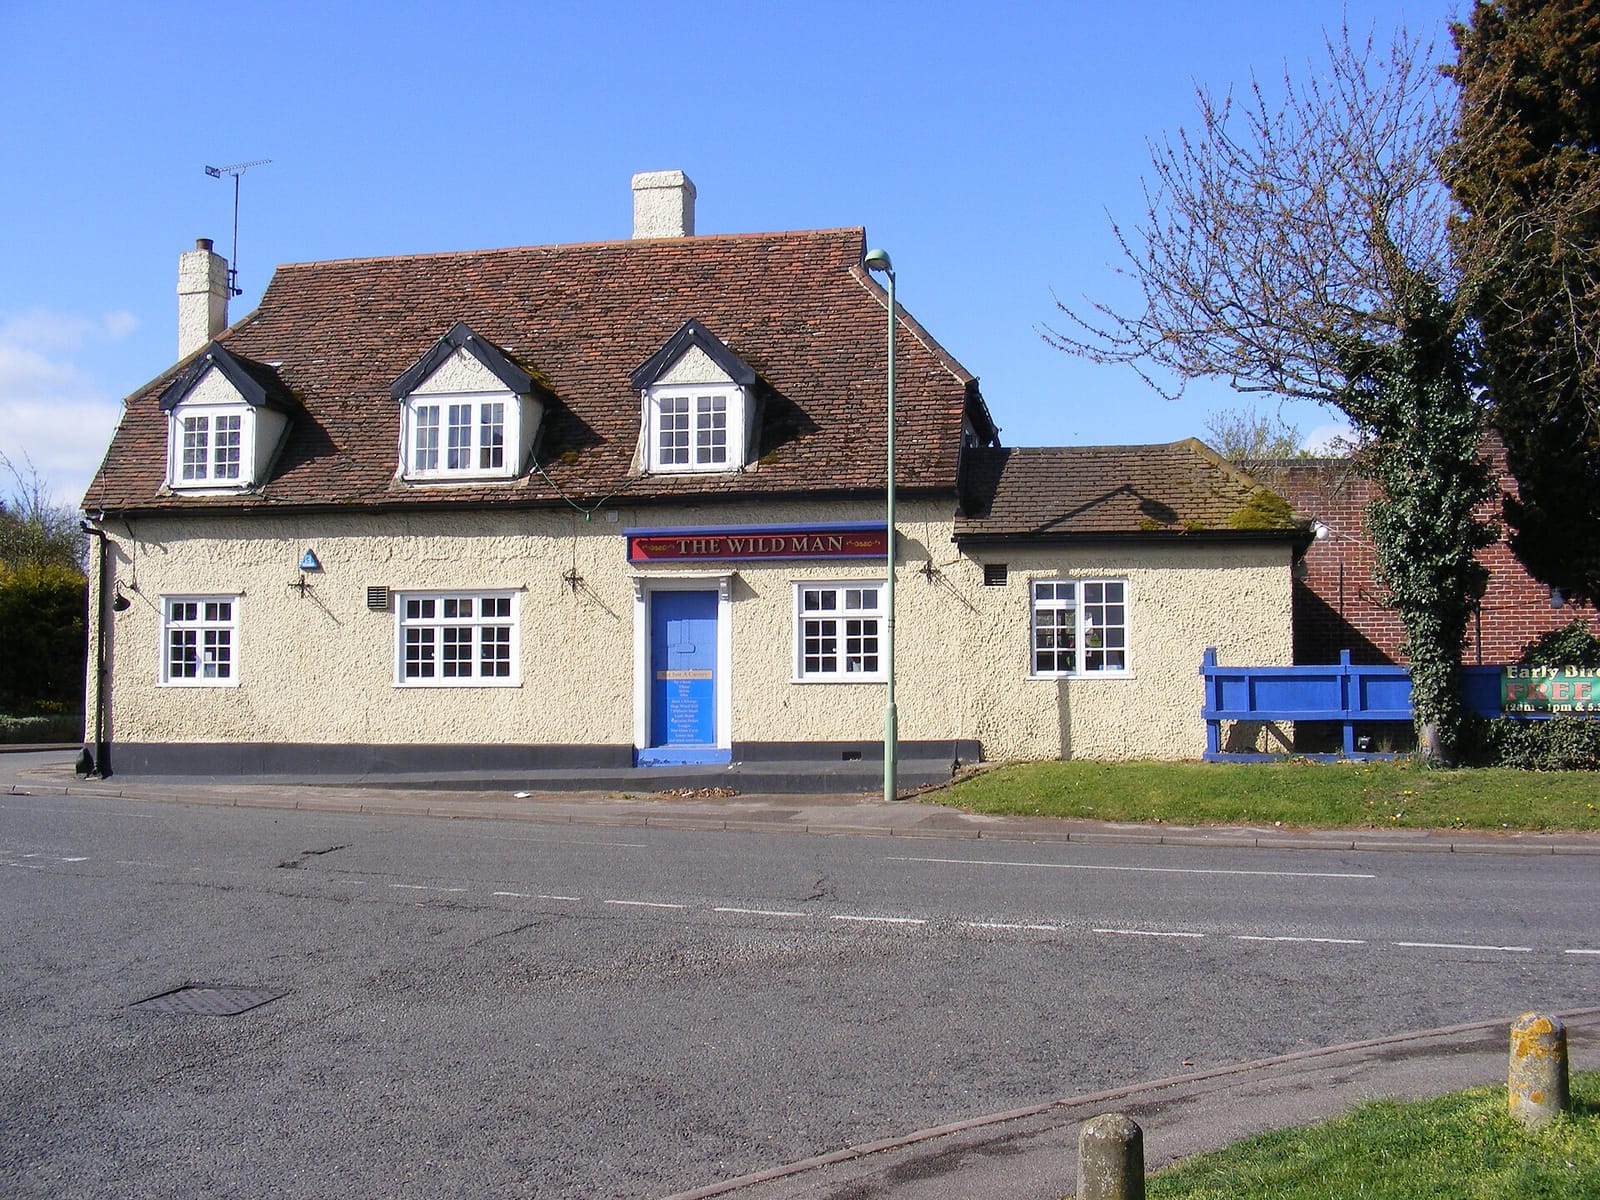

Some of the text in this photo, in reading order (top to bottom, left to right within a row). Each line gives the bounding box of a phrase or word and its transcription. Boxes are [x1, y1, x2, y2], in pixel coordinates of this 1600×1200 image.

[677, 536, 843, 554] THE WILD MAN
[1506, 665, 1559, 681] Early
[1506, 682, 1592, 701] FREE
[1547, 703, 1572, 713] 1pm
[1575, 702, 1585, 712] &
